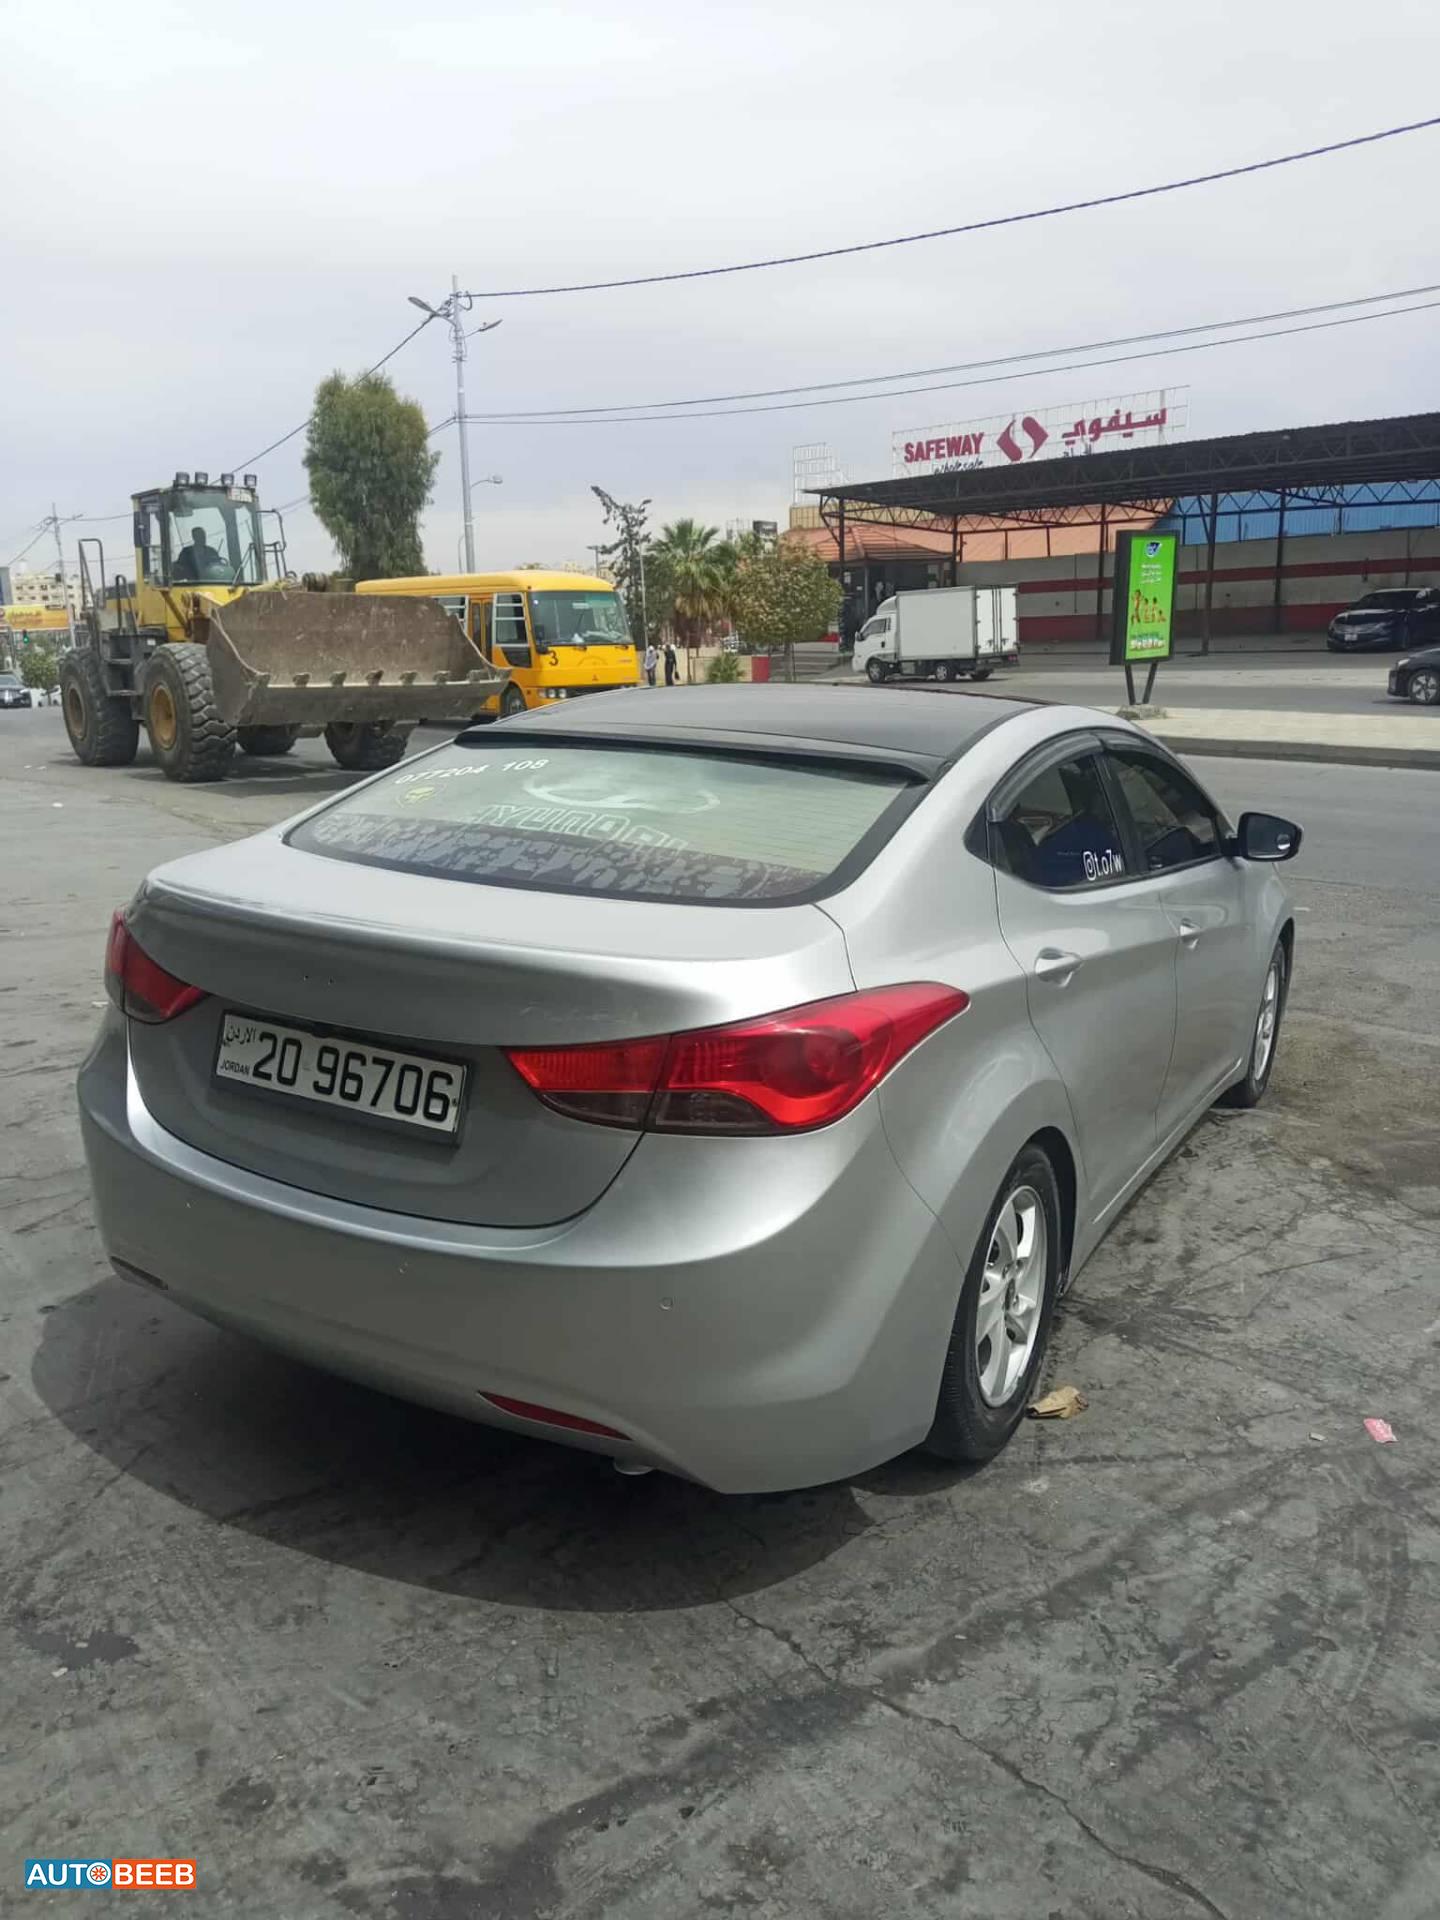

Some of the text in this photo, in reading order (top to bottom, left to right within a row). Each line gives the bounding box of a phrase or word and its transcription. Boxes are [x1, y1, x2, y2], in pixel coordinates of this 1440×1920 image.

[1062, 408, 1166, 445] سيفوي
[904, 432, 984, 463] SAFEWAY
[549, 651, 559, 667] 3
[220, 1060, 251, 1076] JORDAN
[252, 1031, 454, 1123] 20 96706
